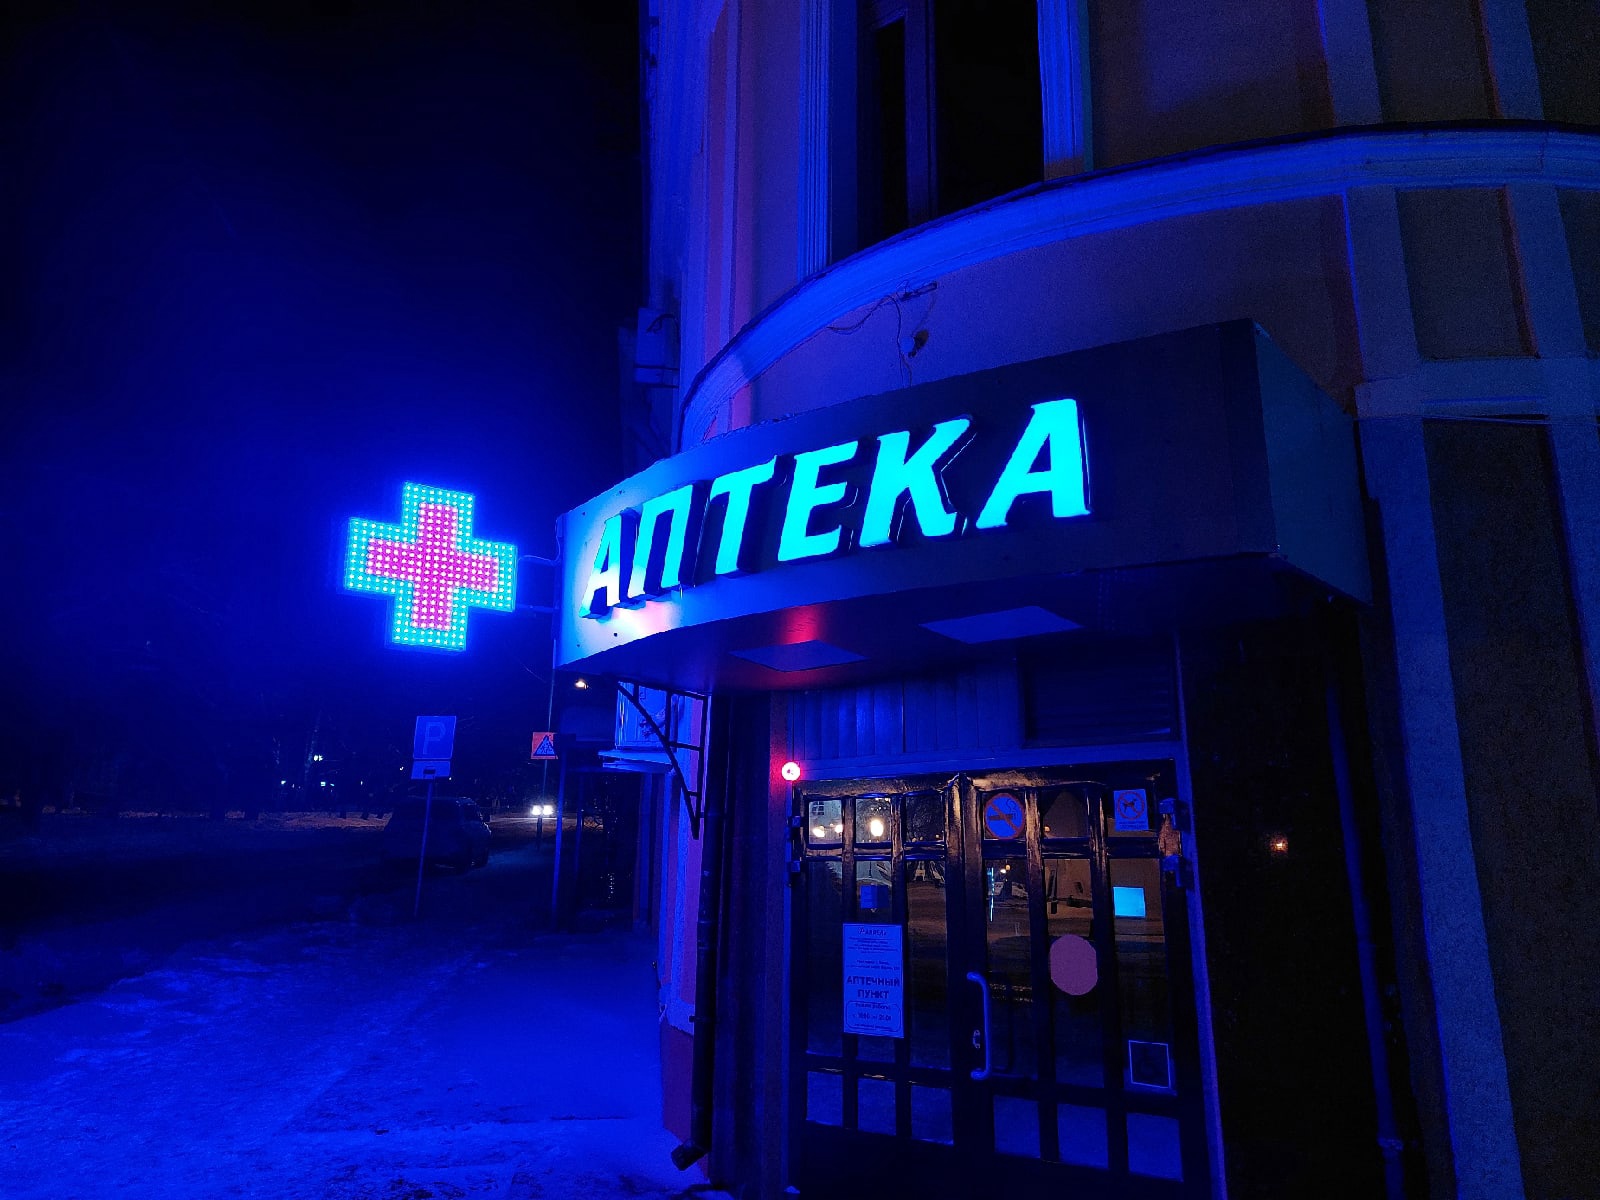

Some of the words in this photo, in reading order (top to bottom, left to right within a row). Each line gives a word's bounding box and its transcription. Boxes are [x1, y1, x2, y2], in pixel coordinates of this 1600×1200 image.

[578, 398, 1091, 618] АПТЕКА
[846, 975, 900, 988] АПТЕЧНЫЙ
[857, 989, 889, 999] ПУНКТ
